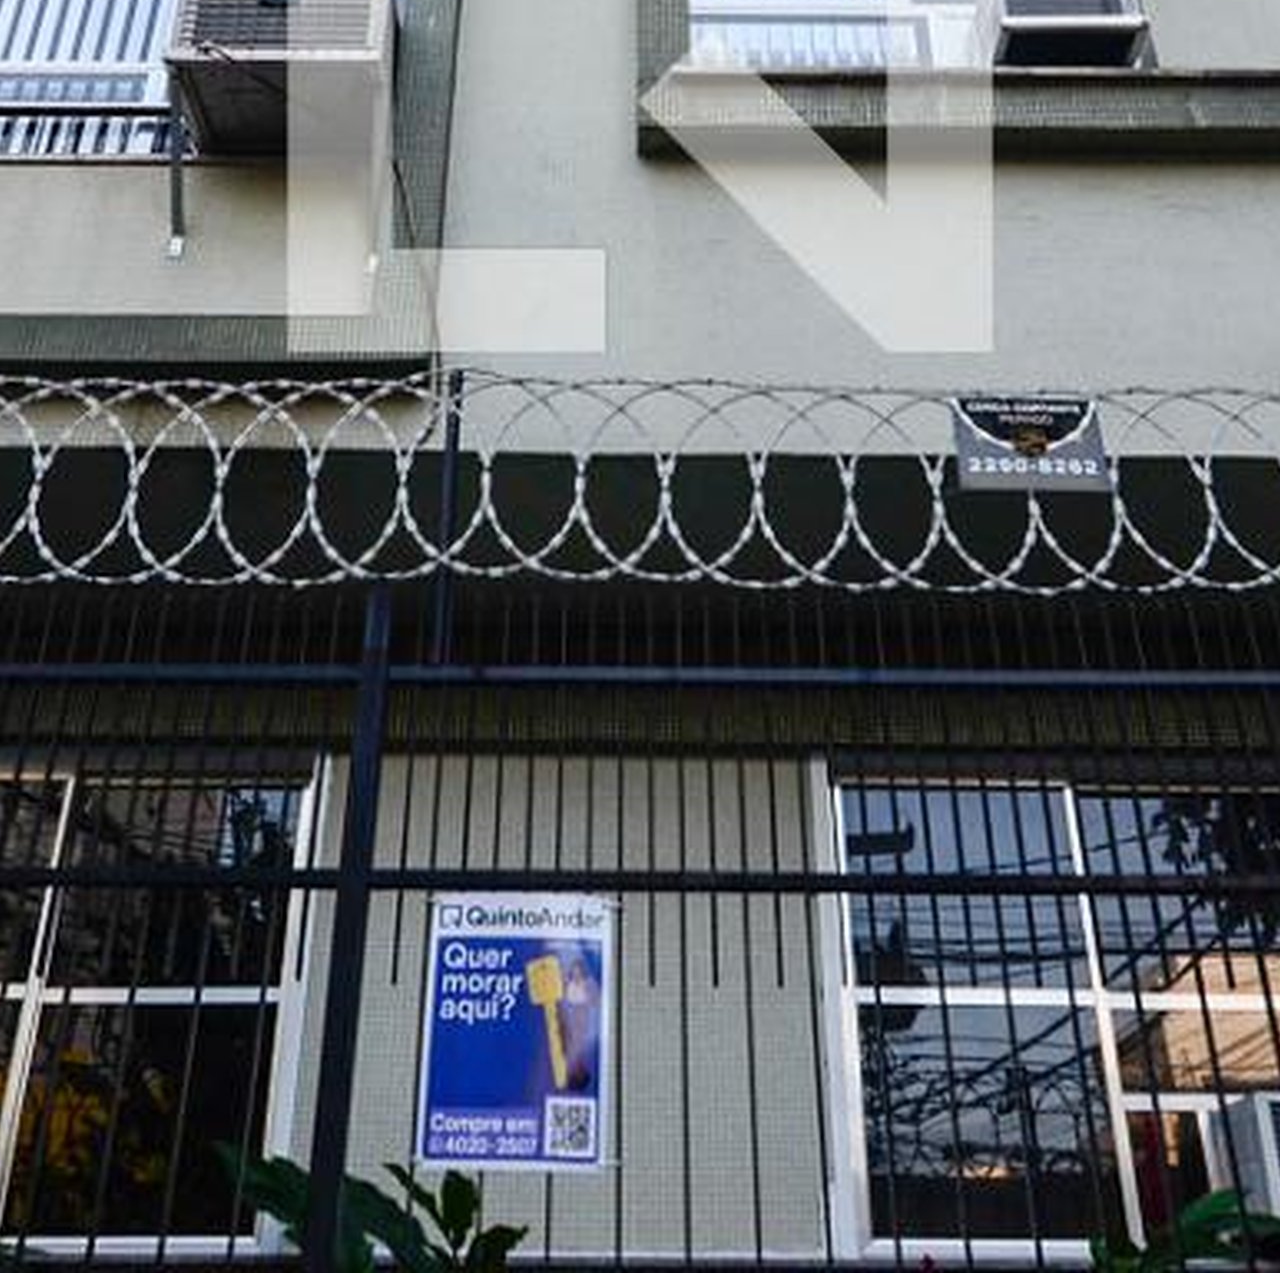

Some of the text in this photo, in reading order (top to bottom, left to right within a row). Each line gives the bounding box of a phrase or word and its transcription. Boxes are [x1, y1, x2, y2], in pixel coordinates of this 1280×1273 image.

[466, 907, 604, 928] QuintoAndar
[443, 942, 512, 969] Quer
[441, 974, 523, 994] morar
[439, 994, 517, 1025] aqui?
[430, 1113, 504, 1133] Compre
